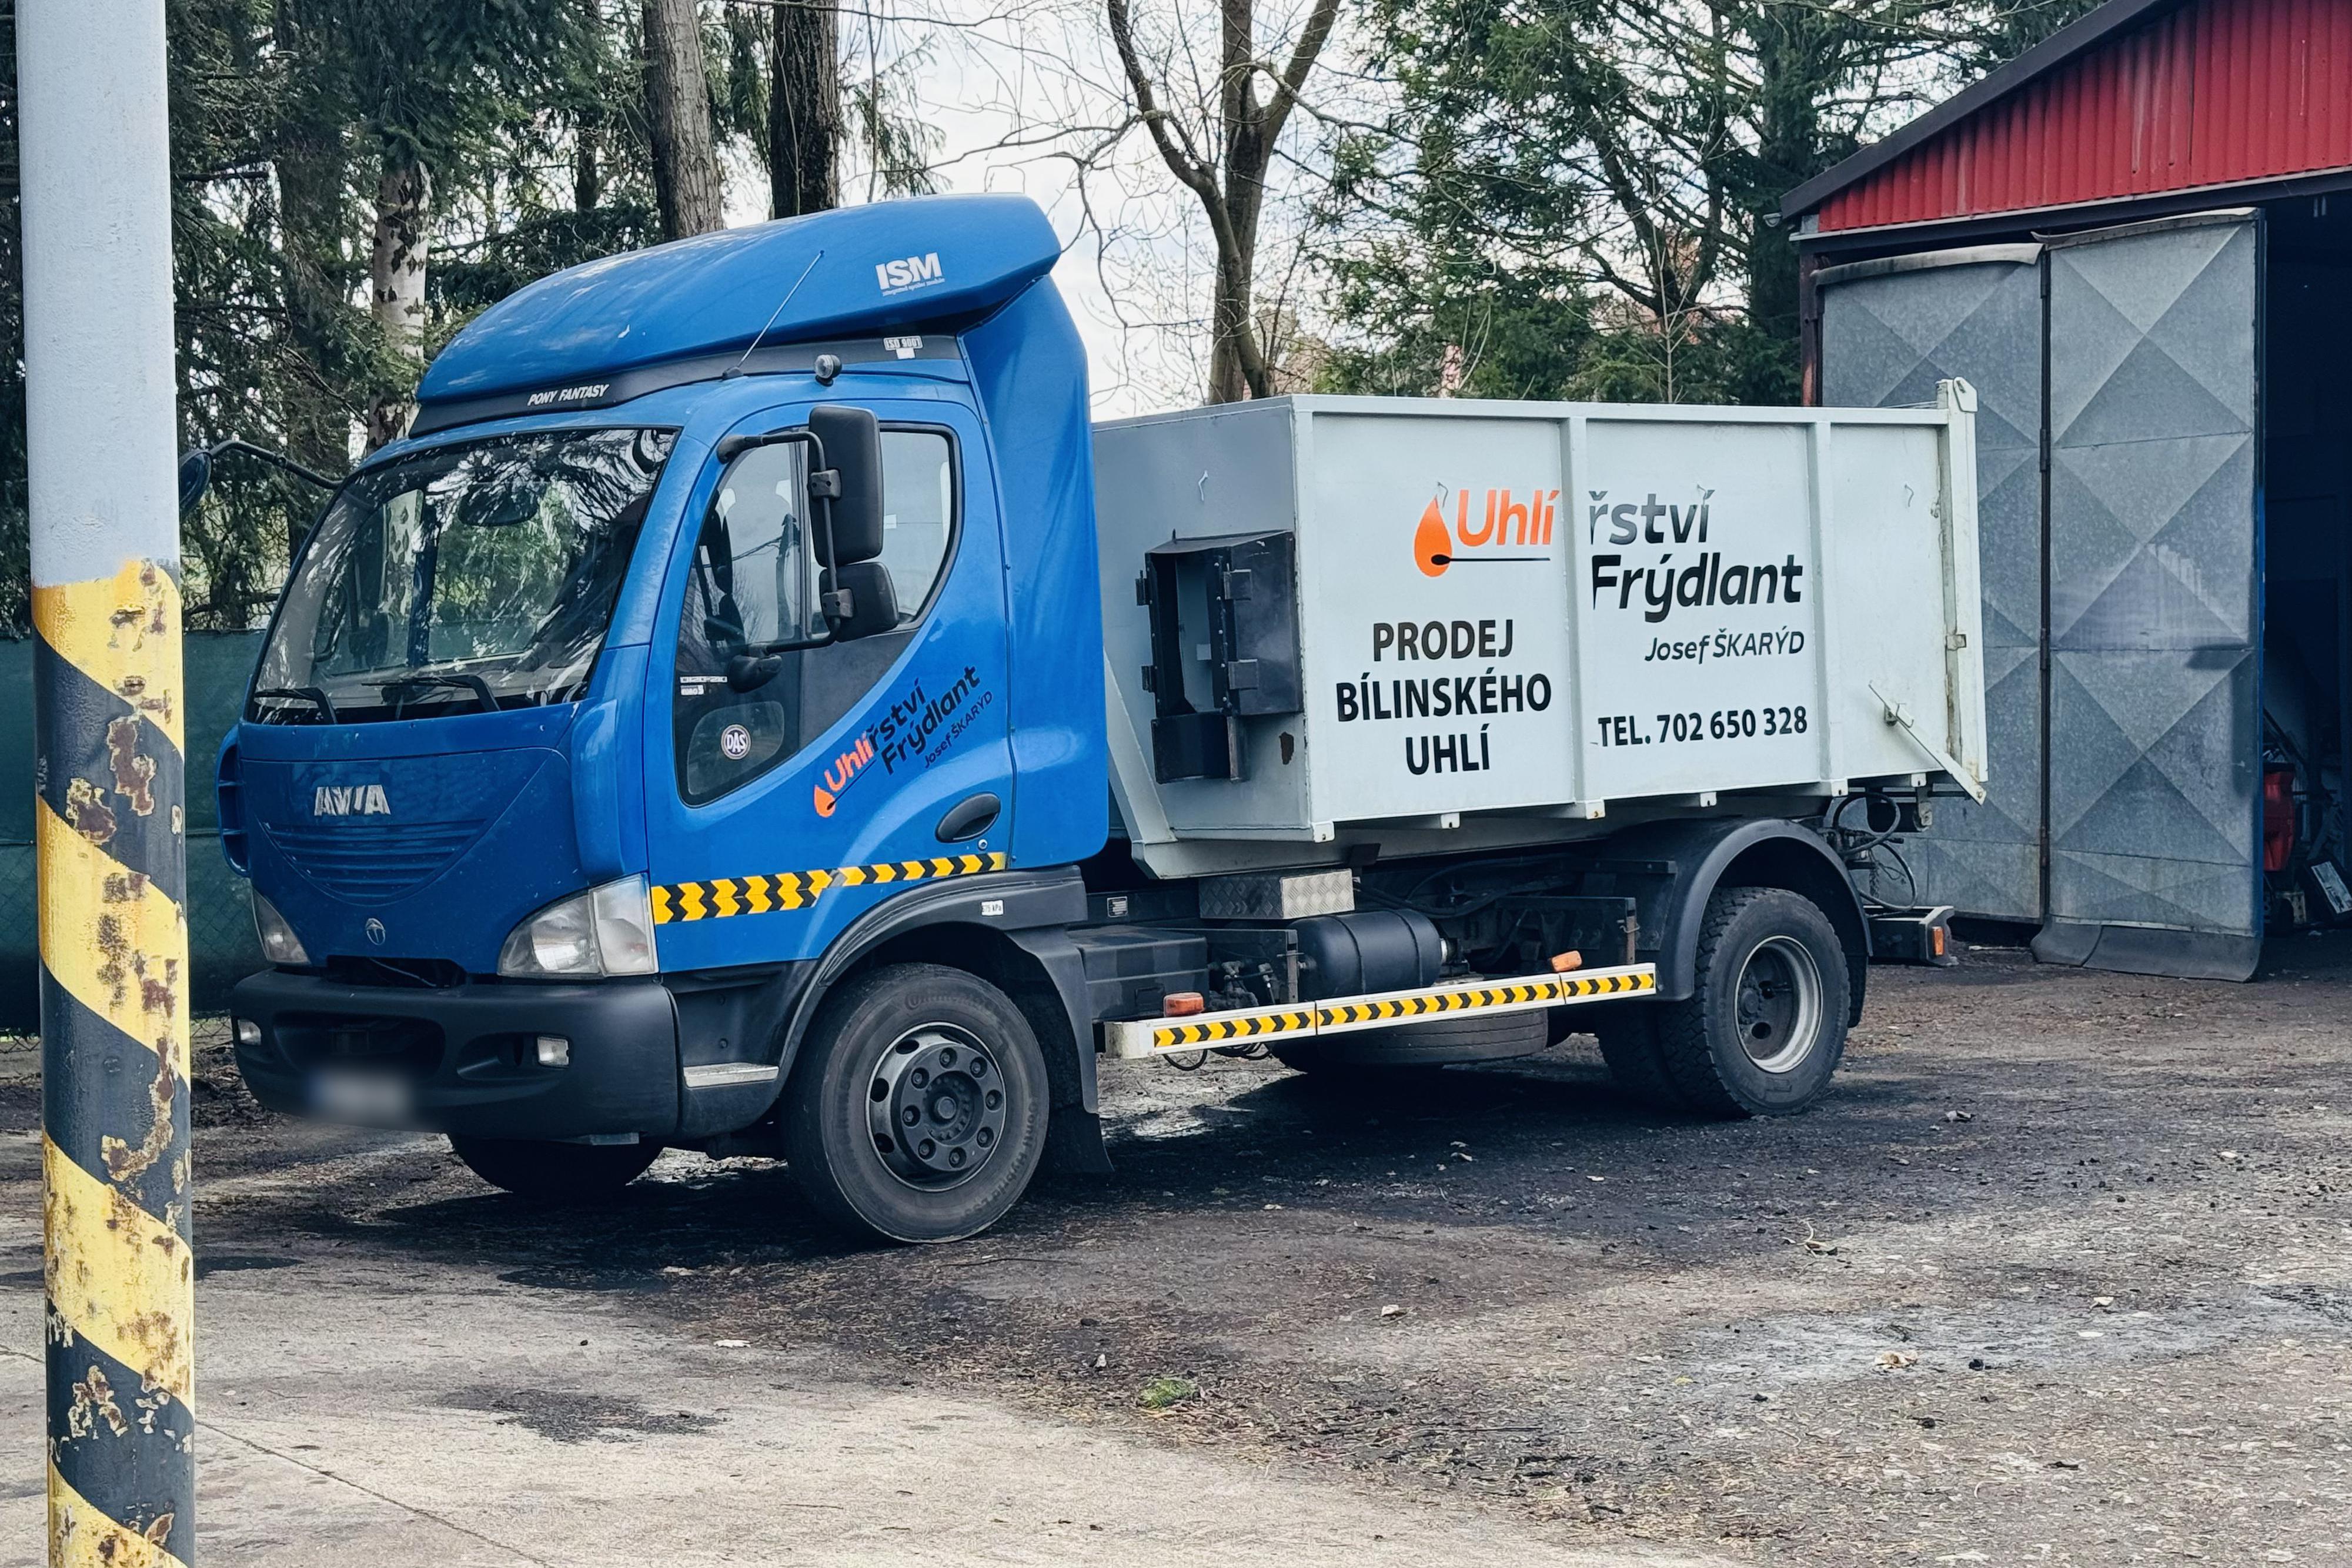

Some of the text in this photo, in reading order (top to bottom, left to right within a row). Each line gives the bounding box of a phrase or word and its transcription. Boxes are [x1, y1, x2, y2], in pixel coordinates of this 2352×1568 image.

[876, 252, 942, 290] ISM
[886, 338, 920, 348] ISO 9001
[527, 384, 610, 406] PONY FANTASY
[1591, 552, 1803, 623] Frýdlant
[1373, 619, 1514, 661] PRODEJ
[1645, 626, 1804, 664] Josef ŠKARÝD
[1336, 667, 1551, 722] BÍLINSKÉHO
[881, 666, 980, 775] Frýdlant
[924, 691, 993, 768] Josef ŠKARÝD
[1598, 706, 1808, 747] TEL. 702 650 328
[727, 732, 746, 753] DAS
[1405, 723, 1491, 775] UHLÍ
[314, 784, 391, 816] AVIA
